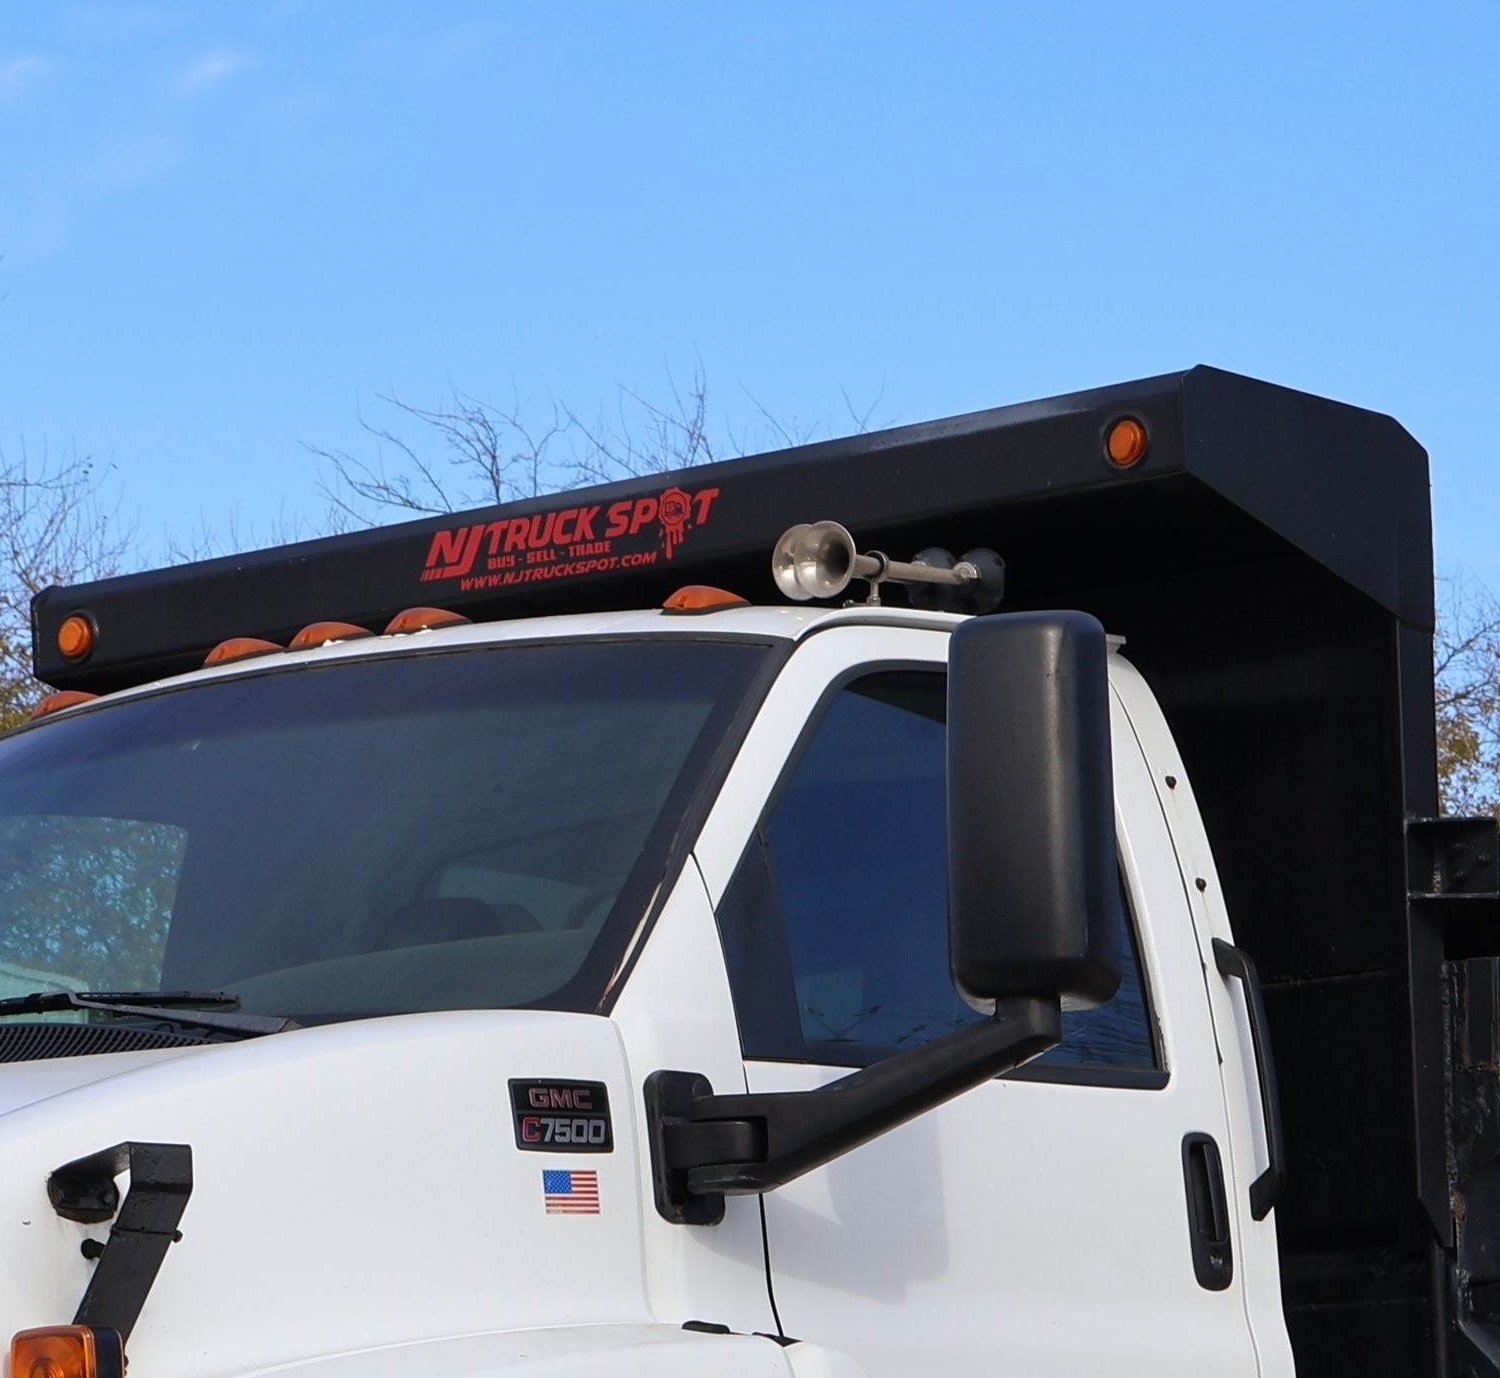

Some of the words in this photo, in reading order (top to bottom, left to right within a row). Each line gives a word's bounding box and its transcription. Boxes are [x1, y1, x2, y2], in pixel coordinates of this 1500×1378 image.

[424, 525, 487, 578] NJ
[486, 506, 602, 552] TRUCK
[605, 486, 720, 539] SPOT
[487, 554, 516, 570] BUY
[526, 550, 557, 565] SELL
[568, 541, 612, 557] TRADE
[460, 551, 658, 591] WWW.NJTRUCKSPOT.COM
[529, 1088, 592, 1109] GMC
[522, 1116, 606, 1144] C7500
